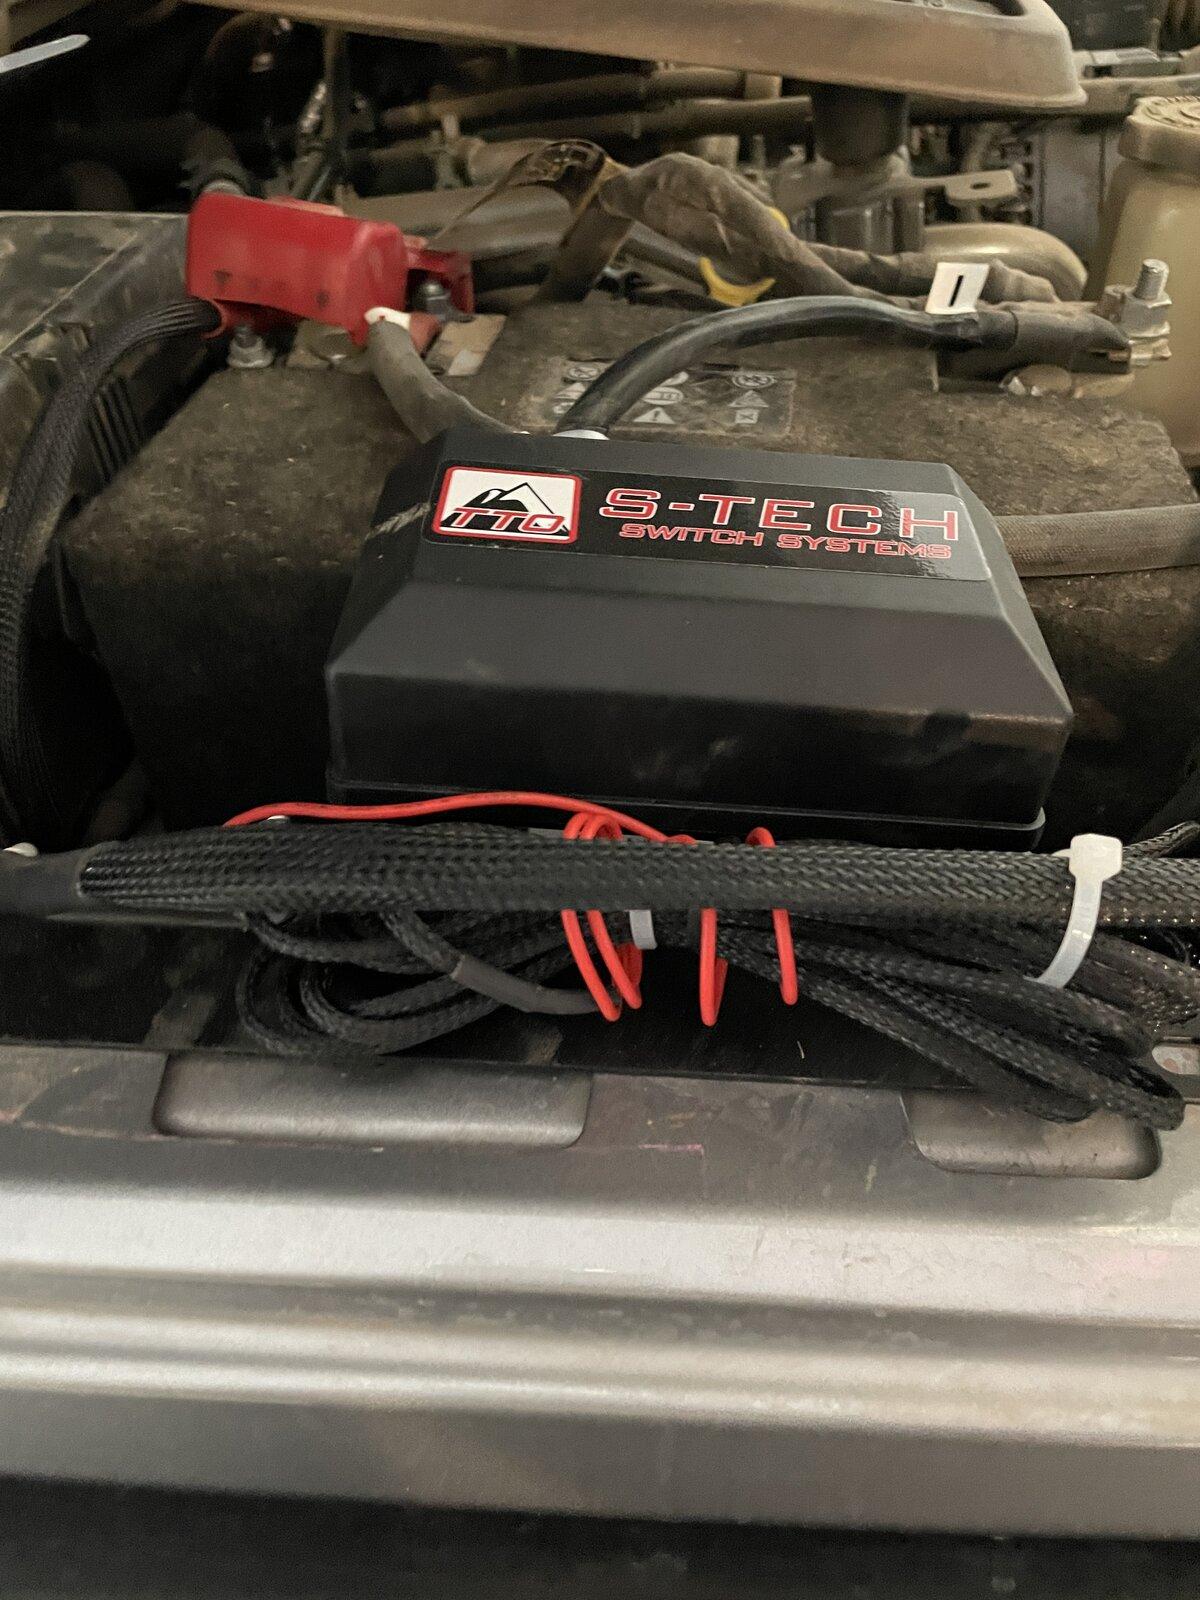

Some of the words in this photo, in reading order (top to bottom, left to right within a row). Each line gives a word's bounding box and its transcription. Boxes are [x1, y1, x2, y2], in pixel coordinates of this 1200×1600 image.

[452, 506, 565, 534] TTO
[599, 487, 959, 541] S-TECH
[619, 523, 764, 547] SWITCH
[776, 533, 952, 559] SYSTEMS
